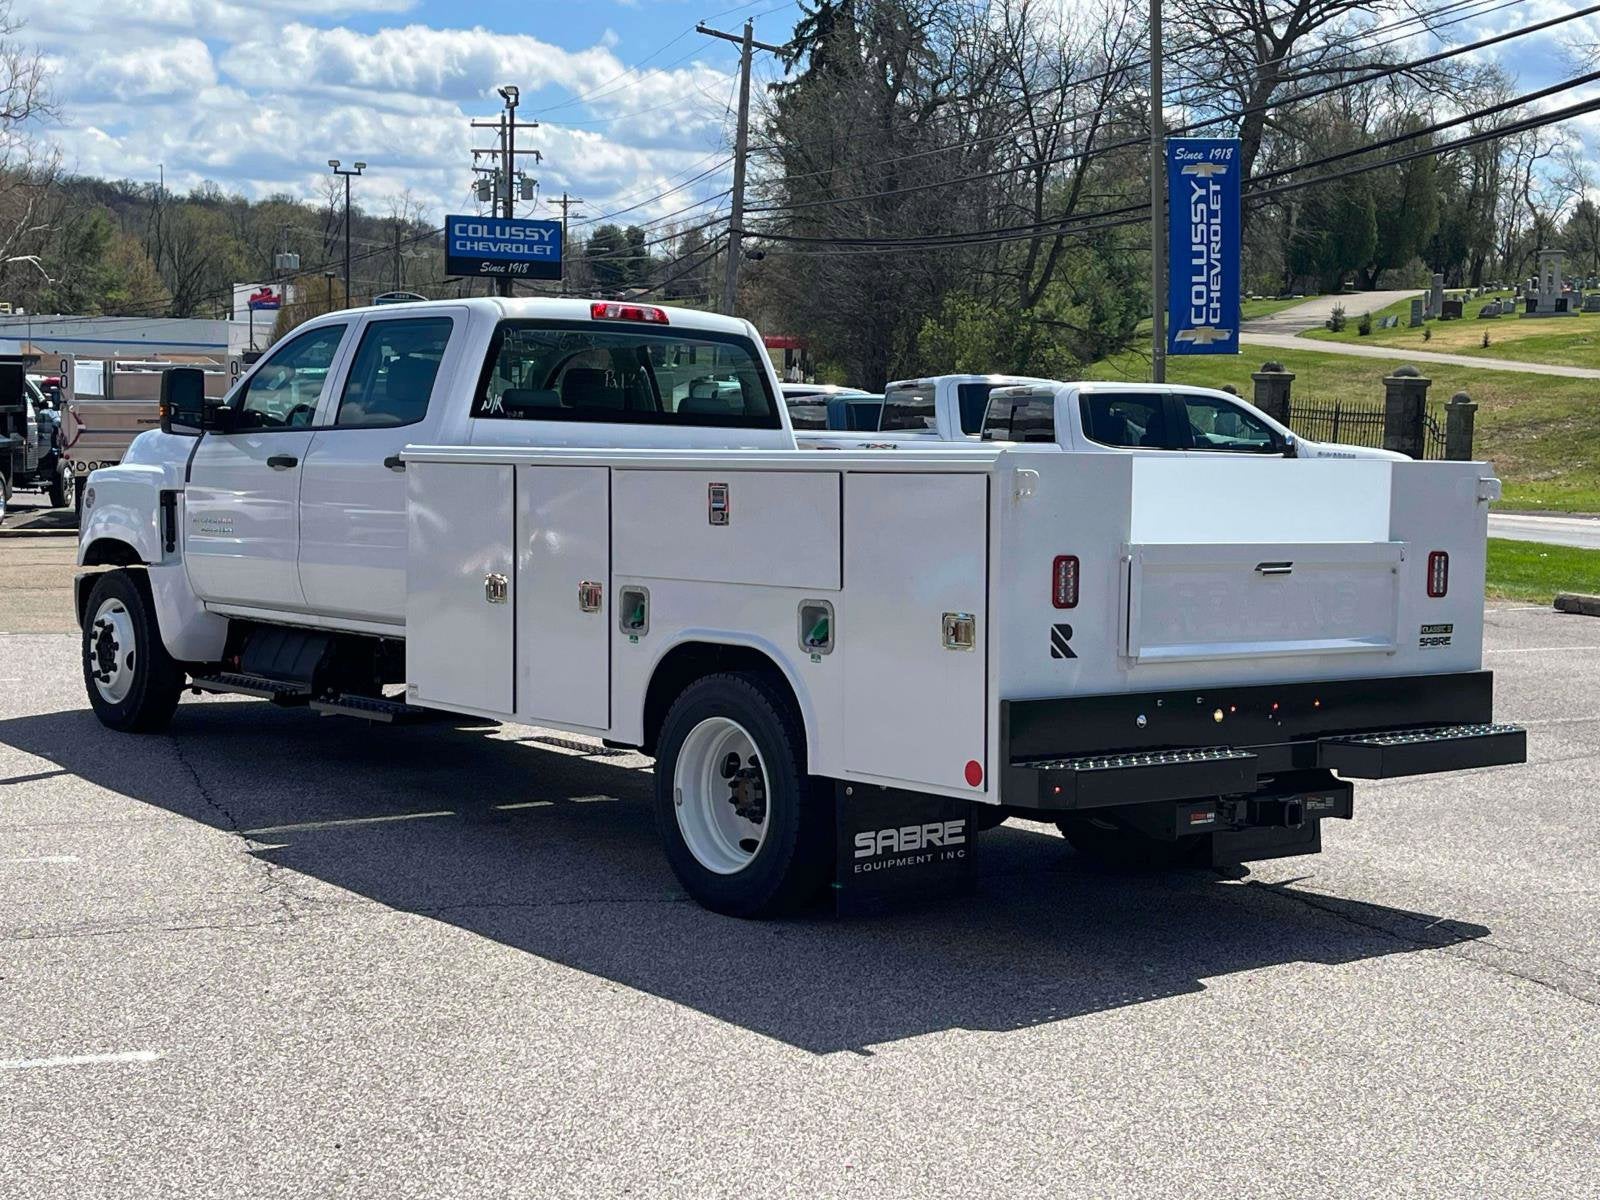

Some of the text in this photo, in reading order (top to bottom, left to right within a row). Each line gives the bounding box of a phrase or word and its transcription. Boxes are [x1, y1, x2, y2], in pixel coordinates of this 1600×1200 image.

[1174, 148, 1234, 160] Since 1918
[454, 223, 555, 241] COLUSSY
[455, 240, 554, 255] CHEVROLET
[1190, 180, 1208, 325] COLUSSY
[1209, 180, 1222, 324] CHEVROLET
[479, 262, 530, 274] Since 1918
[1419, 636, 1452, 647] SABRE
[854, 819, 966, 859] SABRE
[854, 849, 966, 874] EQUIPMENT INC
